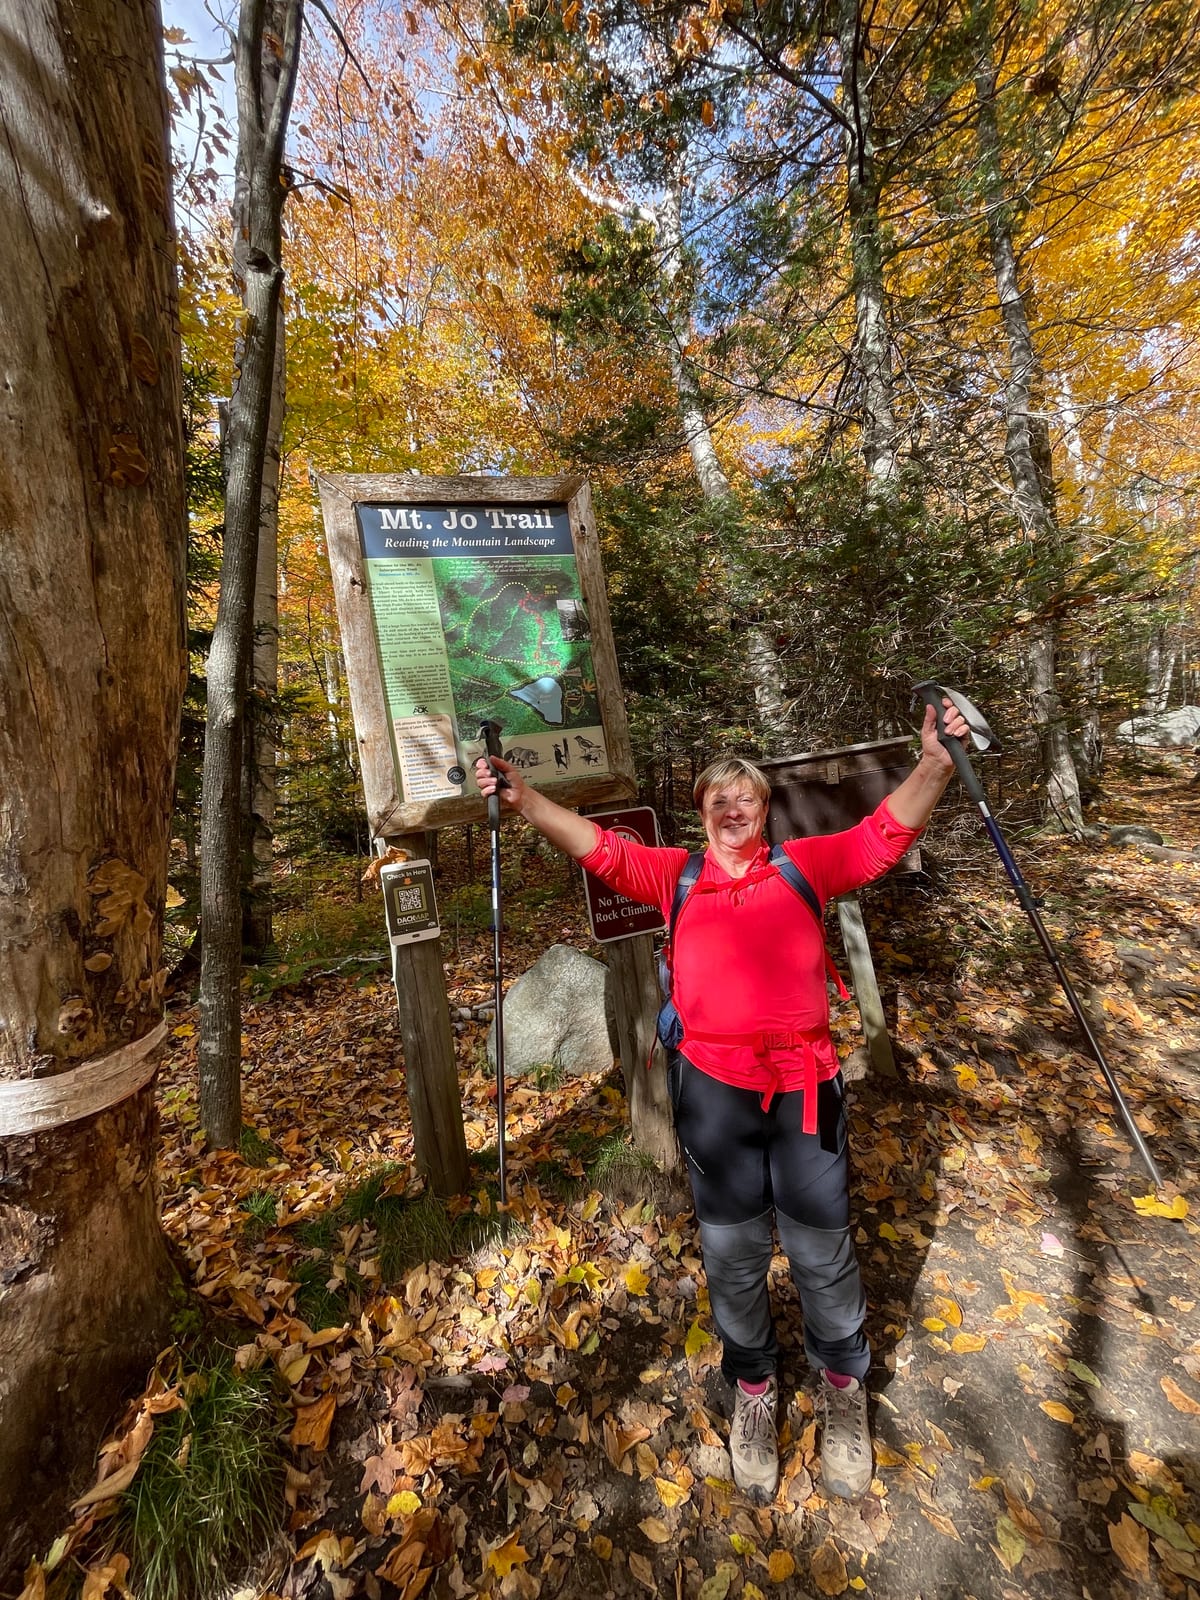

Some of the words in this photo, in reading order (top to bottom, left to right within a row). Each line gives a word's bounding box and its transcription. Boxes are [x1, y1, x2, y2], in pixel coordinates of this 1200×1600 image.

[378, 508, 432, 530] Mt.
[443, 508, 478, 530] Jo
[485, 508, 554, 530] Trail
[384, 537, 430, 549] Reading
[432, 537, 449, 548] the
[451, 536, 501, 547] Mountain
[504, 536, 556, 547] Landscape
[386, 872, 405, 880] Check
[598, 896, 612, 908] No
[595, 909, 619, 923] Rock
